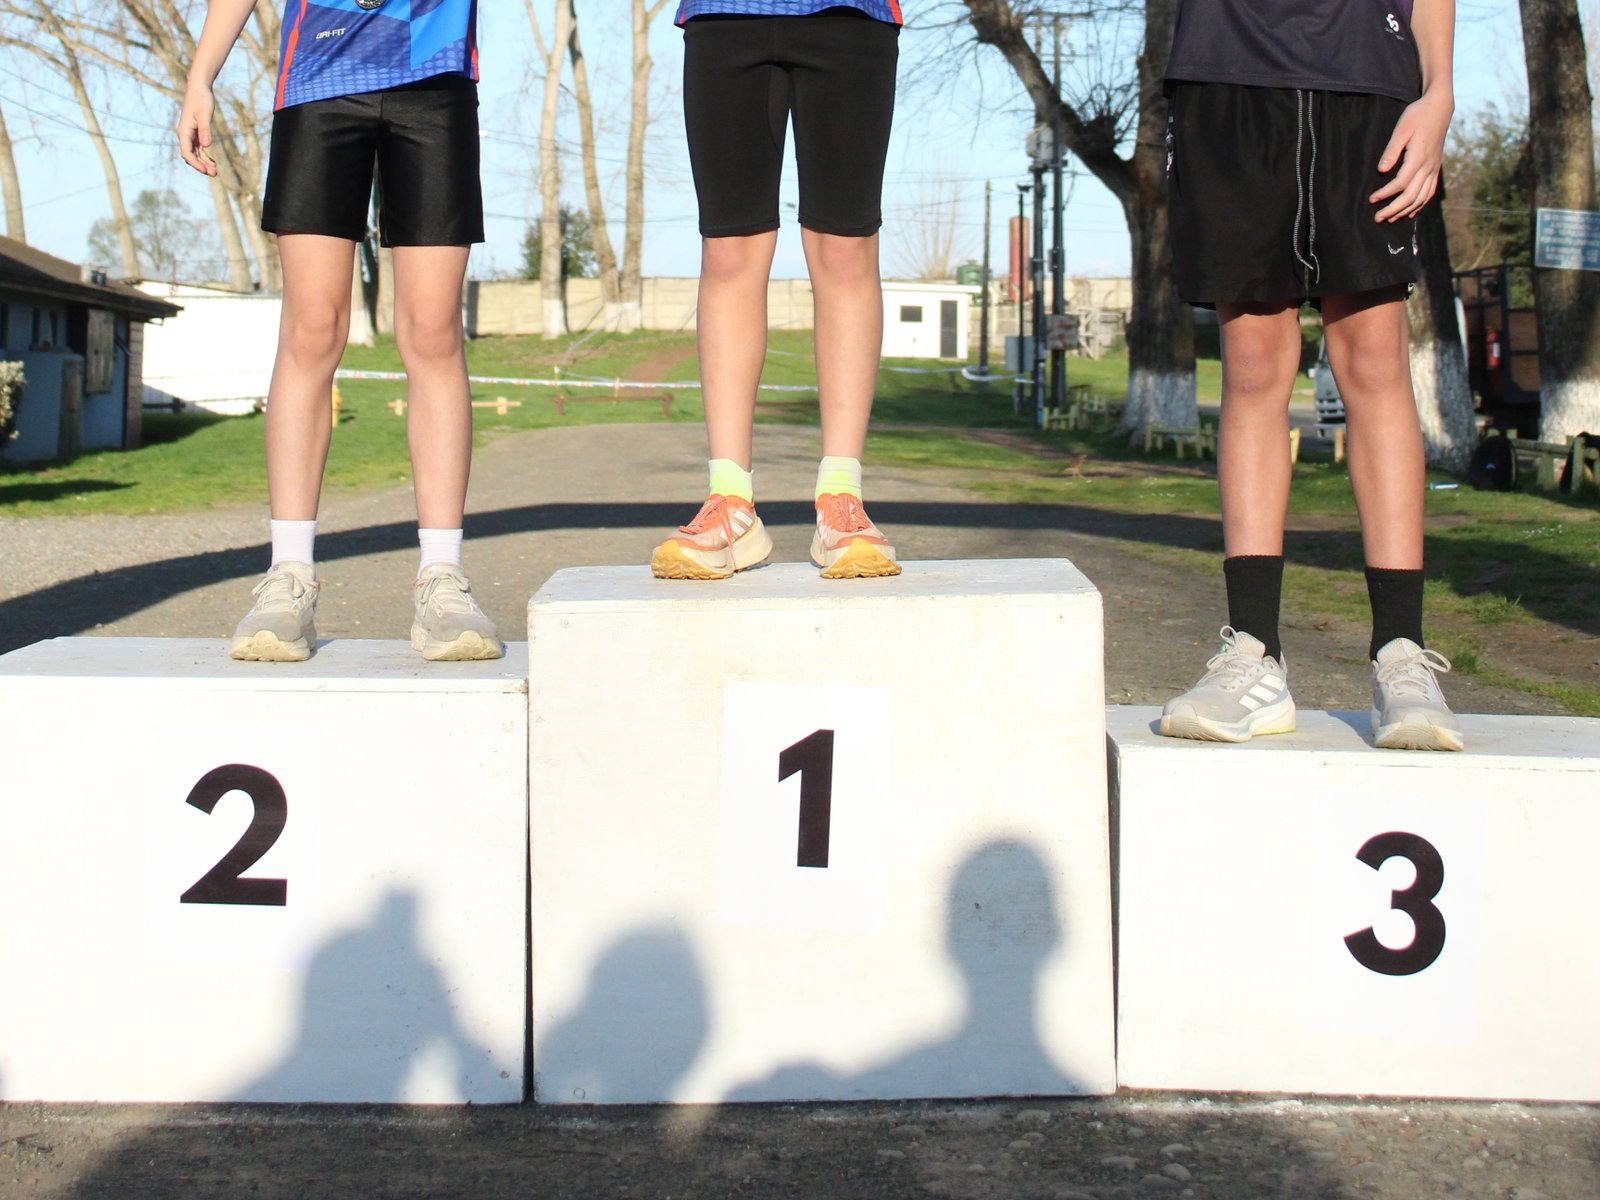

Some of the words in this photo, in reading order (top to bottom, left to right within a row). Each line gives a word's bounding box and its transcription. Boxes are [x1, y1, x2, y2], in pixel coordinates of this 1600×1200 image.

[180, 763, 288, 906] 2
[778, 729, 834, 868] 1
[1343, 831, 1446, 976] 3
